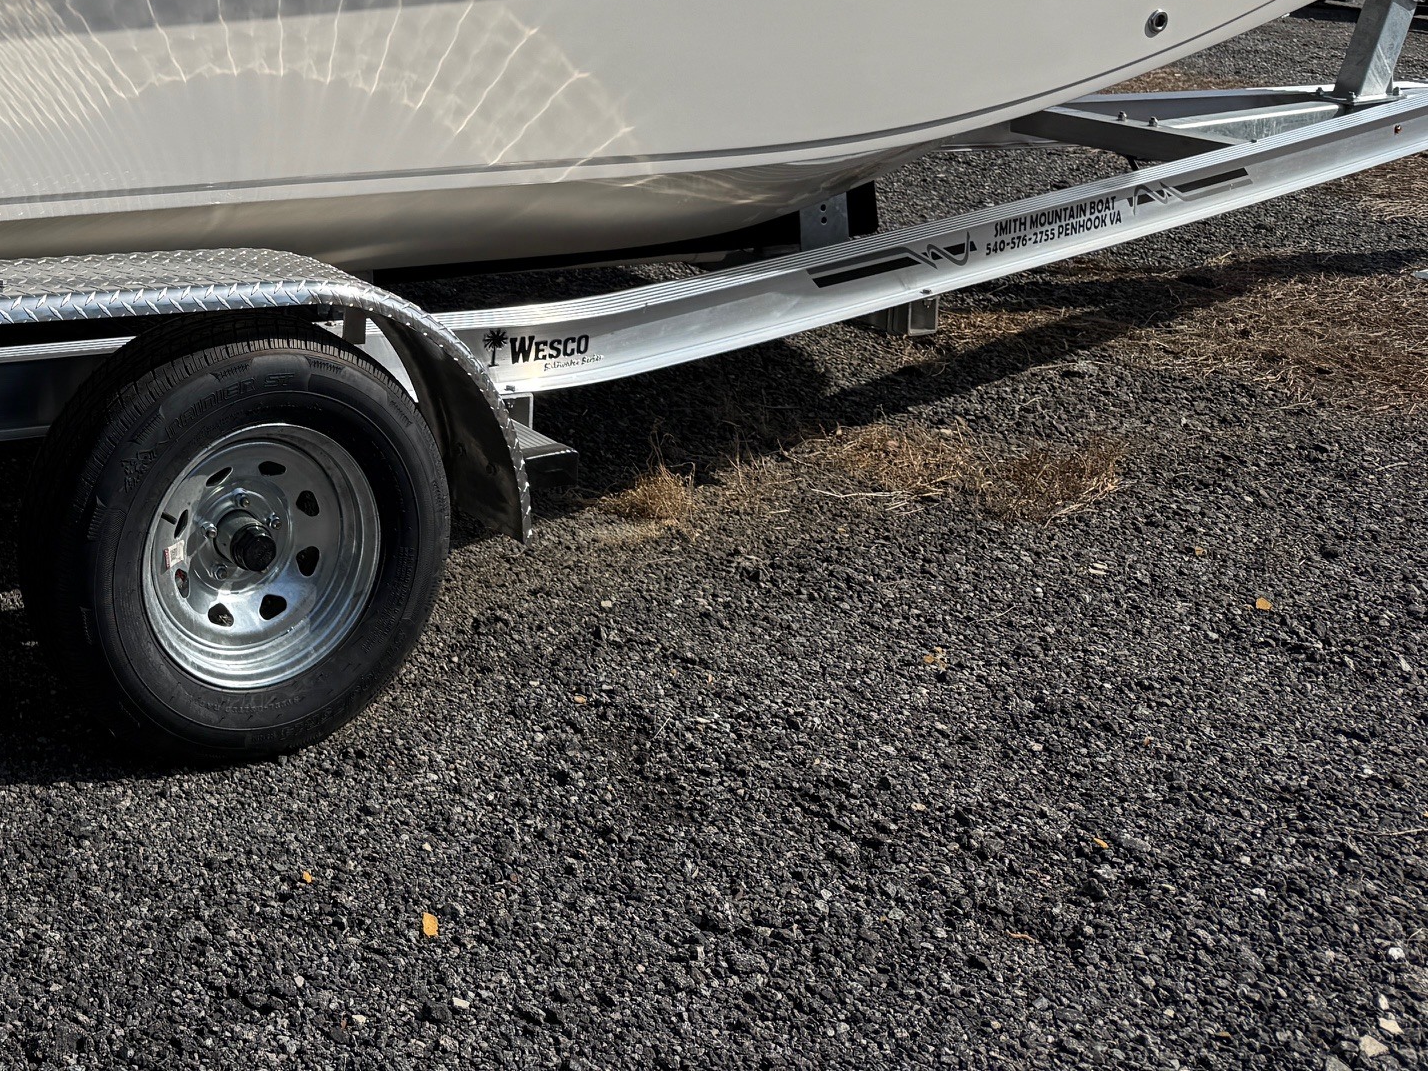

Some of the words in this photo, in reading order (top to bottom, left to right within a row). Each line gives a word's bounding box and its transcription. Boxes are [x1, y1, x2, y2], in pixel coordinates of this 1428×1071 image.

[985, 227, 1055, 256] 540-576-2755
[1057, 213, 1108, 239] PENHOOK
[1109, 210, 1122, 226] VA
[993, 216, 1027, 238] SMITH
[1029, 203, 1087, 230] MOUNTAIN
[1089, 195, 1117, 216] BOAT
[509, 334, 590, 365] WESCO
[264, 372, 296, 388] ST
